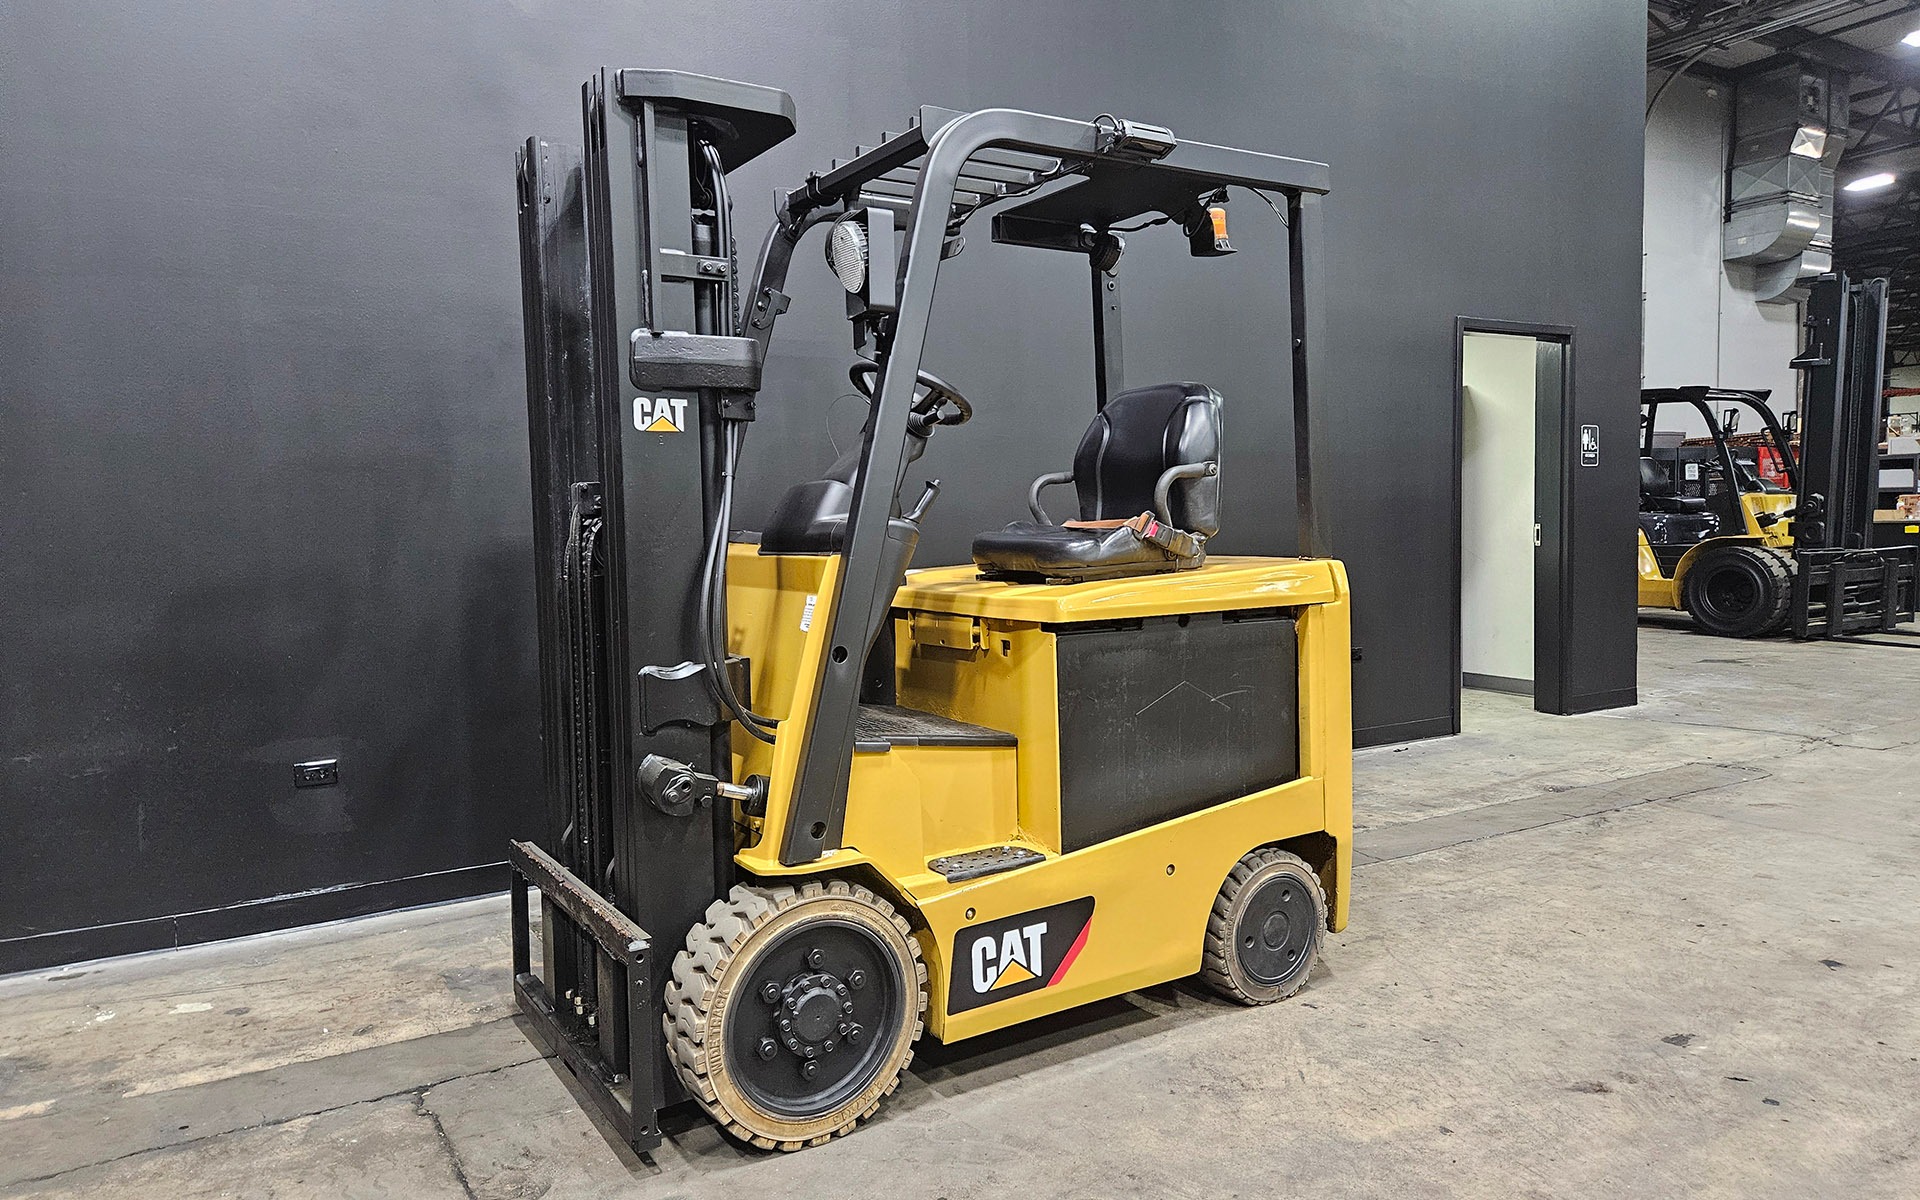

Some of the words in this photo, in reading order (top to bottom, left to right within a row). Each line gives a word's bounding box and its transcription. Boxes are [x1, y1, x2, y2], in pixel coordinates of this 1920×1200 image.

[633, 397, 688, 432] CAT
[971, 921, 1048, 994] CAT
[709, 989, 730, 1037] TRACK
[709, 1039, 724, 1077] WIDE
